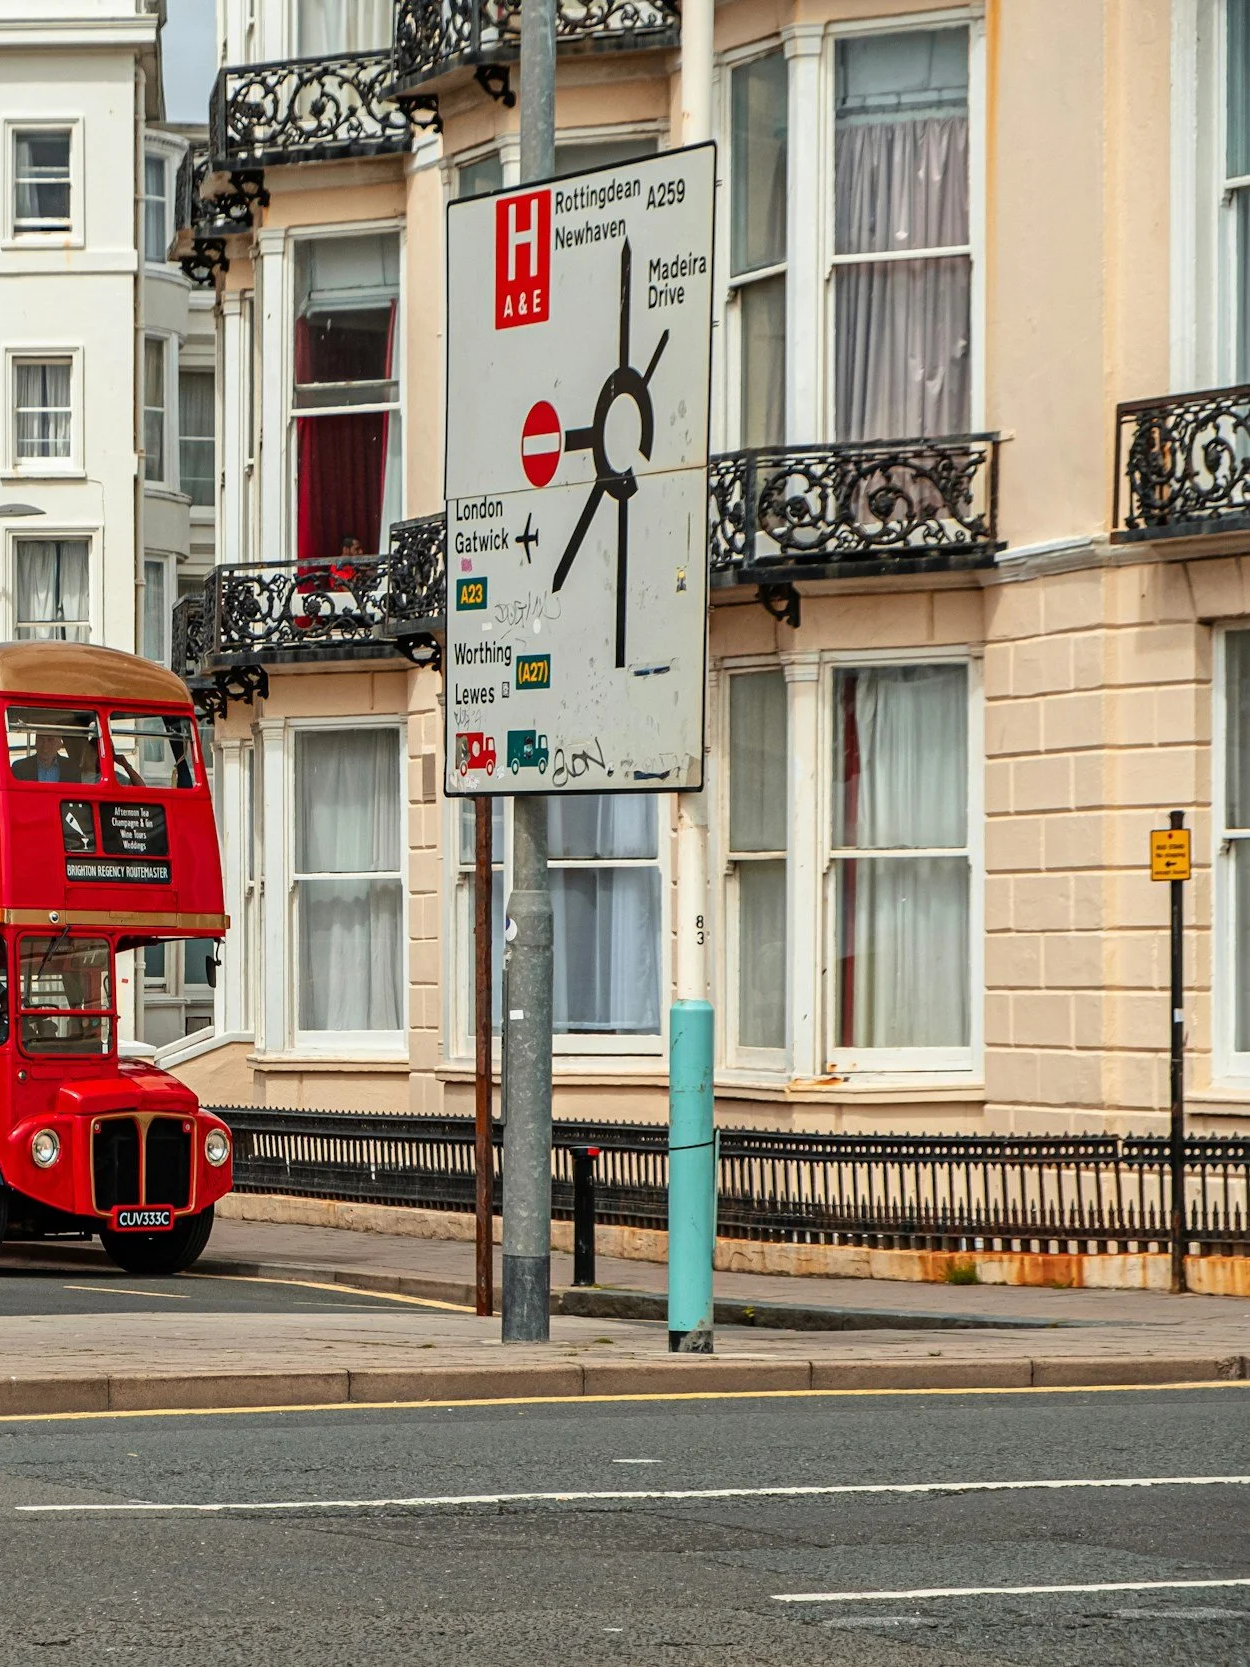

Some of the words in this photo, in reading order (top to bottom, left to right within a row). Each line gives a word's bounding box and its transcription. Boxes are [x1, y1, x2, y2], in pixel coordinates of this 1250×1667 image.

[554, 177, 641, 215] Rottingdean
[646, 178, 686, 211] A259
[554, 217, 627, 250] Newhaven
[648, 252, 707, 282] Madeira
[647, 284, 685, 310] Drive
[455, 497, 503, 521] London
[454, 528, 509, 554] Gatwick
[459, 583, 483, 605] A23
[454, 641, 512, 668] Worthing
[517, 660, 549, 684] (A27)
[454, 683, 496, 706] Lewes
[114, 806, 140, 817] Afternoon
[141, 807, 150, 817] Tea
[111, 817, 139, 830] Champagne
[119, 829, 133, 839] Wine
[134, 829, 147, 839] Tours
[122, 840, 147, 851] Weddings
[66, 864, 97, 877] BRIGHTON
[97, 865, 125, 878] REGENCY
[125, 866, 169, 879] ROUTEMASTER
[118, 1210, 170, 1227] CUV333C
